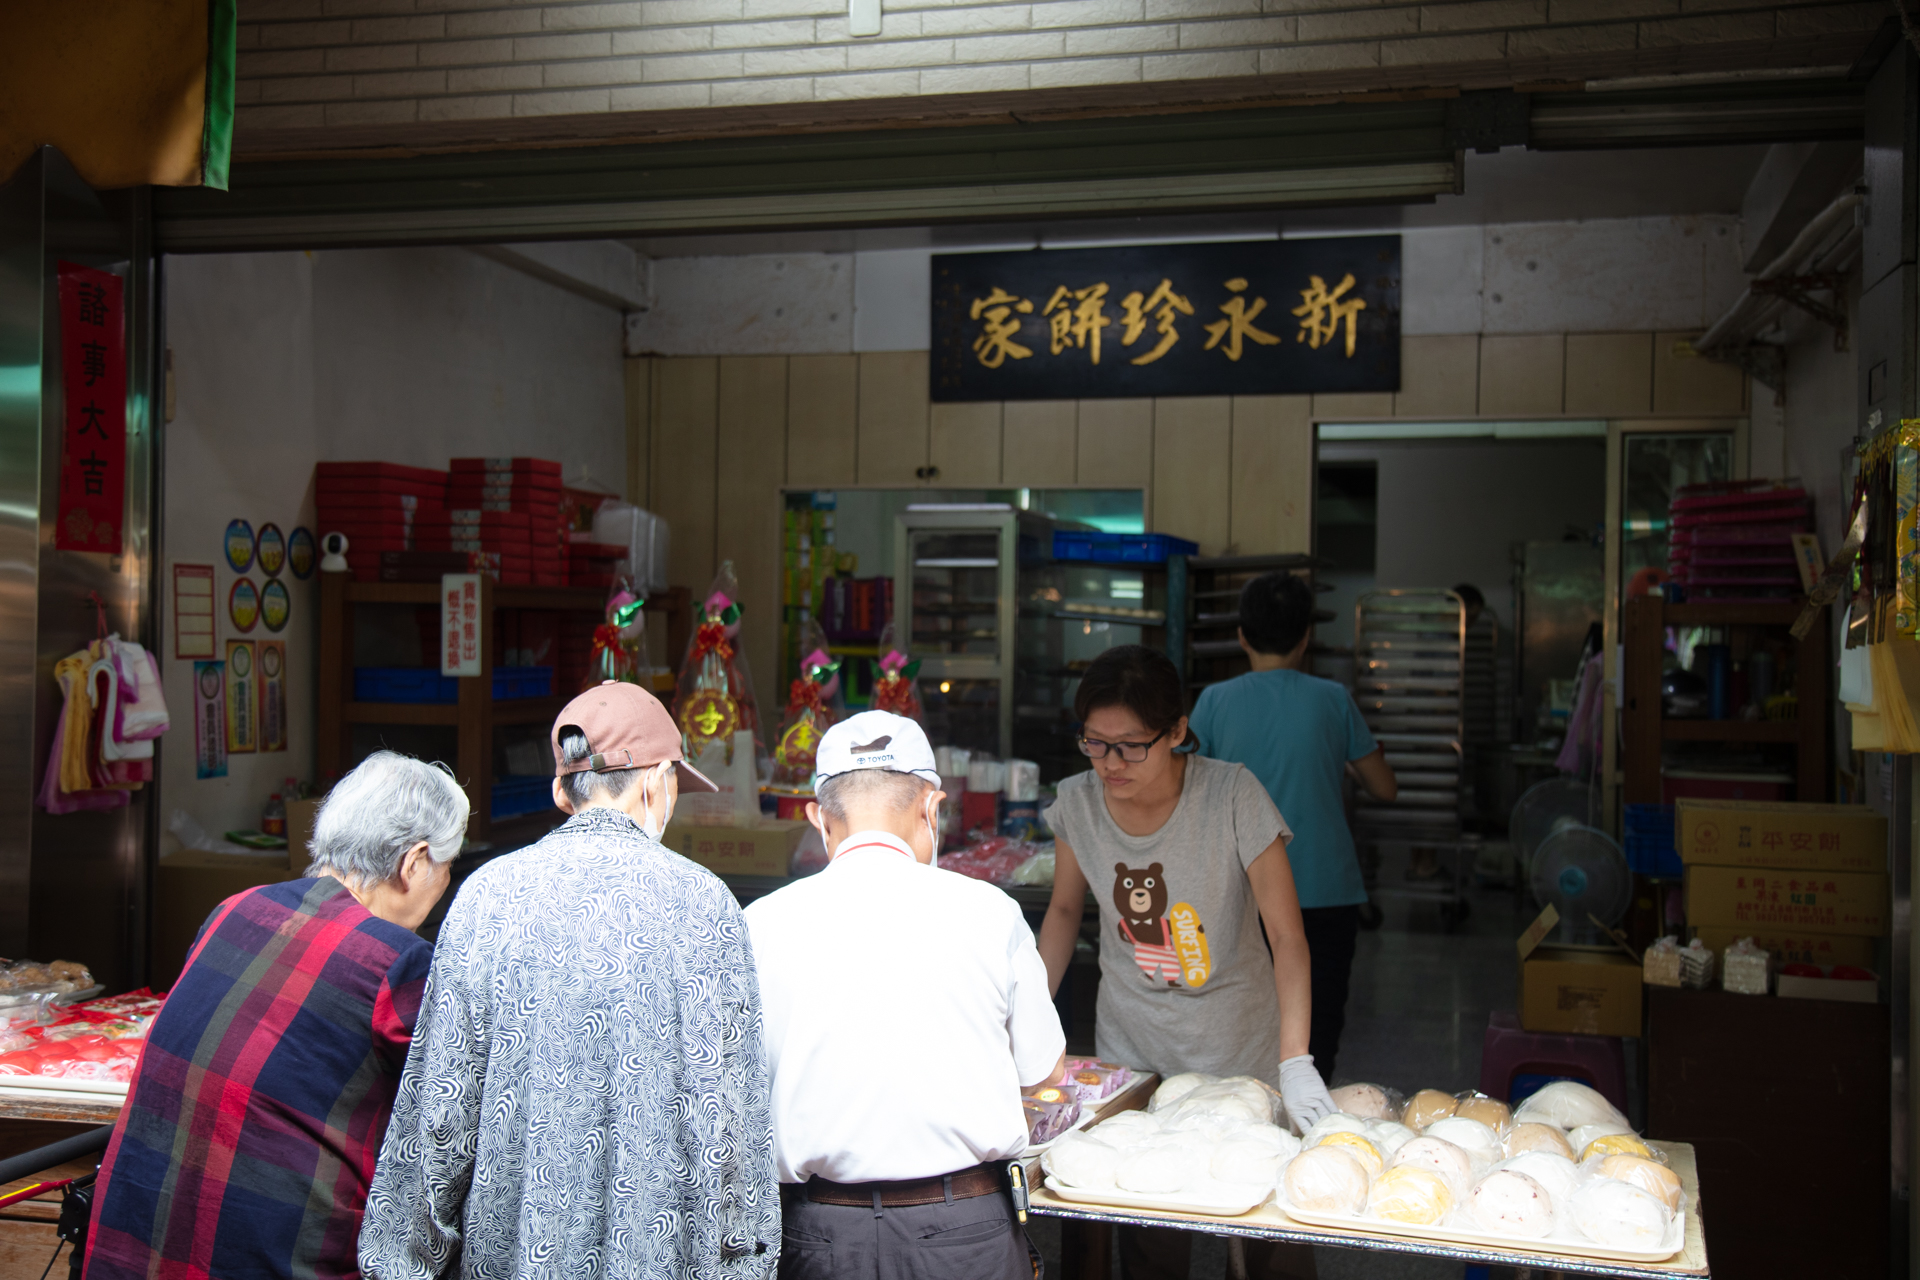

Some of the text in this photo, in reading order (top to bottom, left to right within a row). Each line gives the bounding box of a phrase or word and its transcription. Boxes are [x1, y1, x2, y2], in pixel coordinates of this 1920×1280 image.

[447, 589, 461, 670] 概不退換
[463, 580, 477, 661] 貨物售出
[867, 754, 895, 763] TOYOTA
[697, 840, 755, 858] 平安餅
[1761, 831, 1841, 852] 平安餅
[1172, 909, 1207, 981] SURFING
